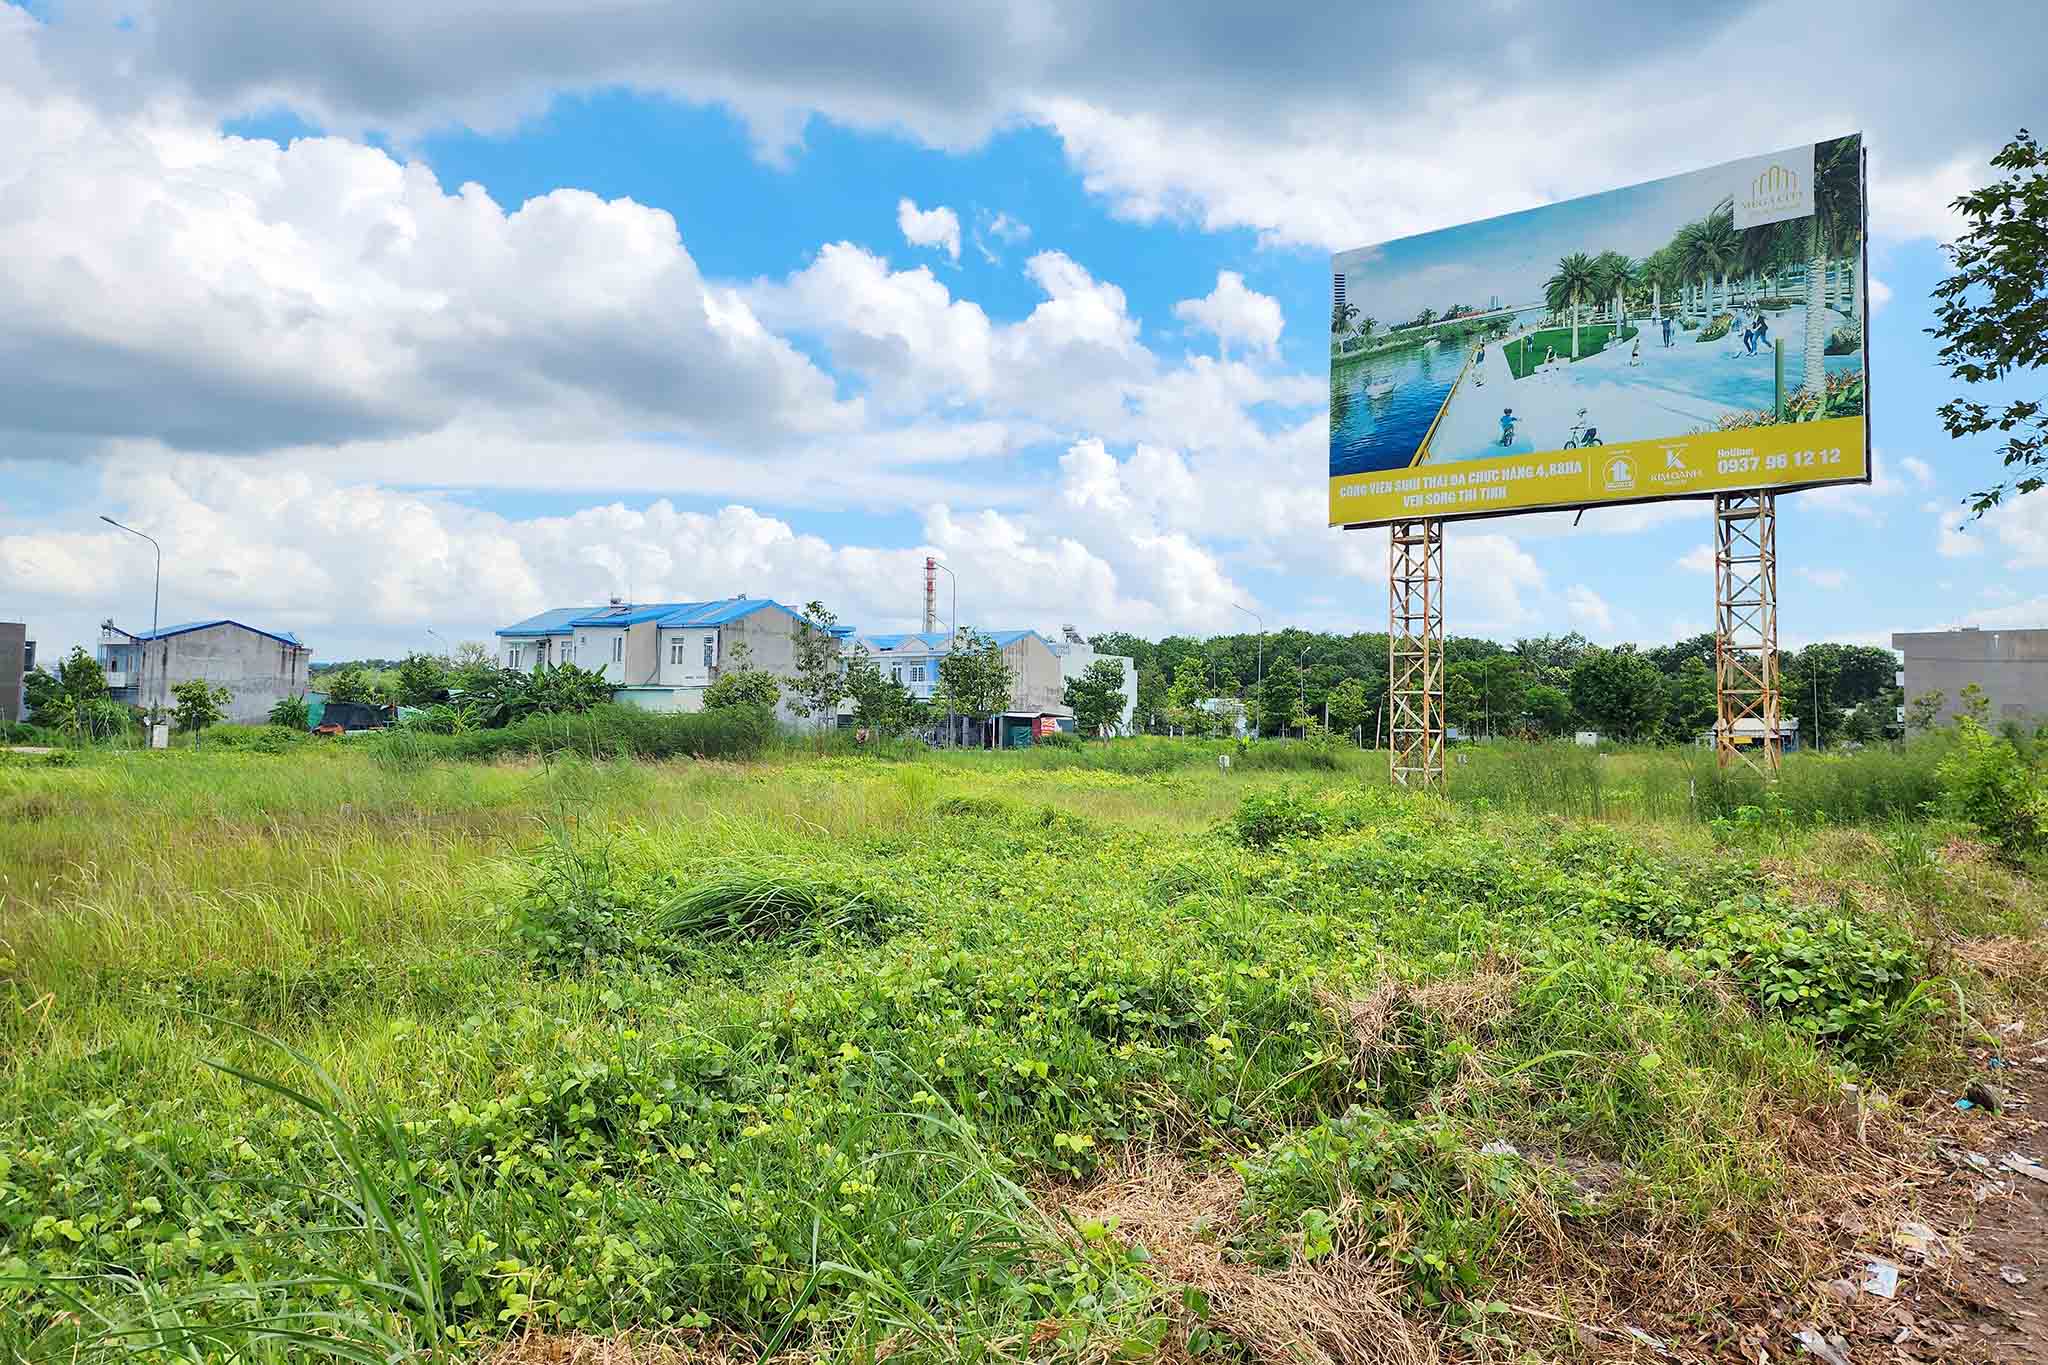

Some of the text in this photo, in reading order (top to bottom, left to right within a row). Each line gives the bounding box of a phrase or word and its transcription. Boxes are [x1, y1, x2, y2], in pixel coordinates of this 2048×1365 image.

[1717, 456, 1760, 474] 0937
[1793, 450, 1815, 465] 12
[1820, 447, 1841, 464] 12
